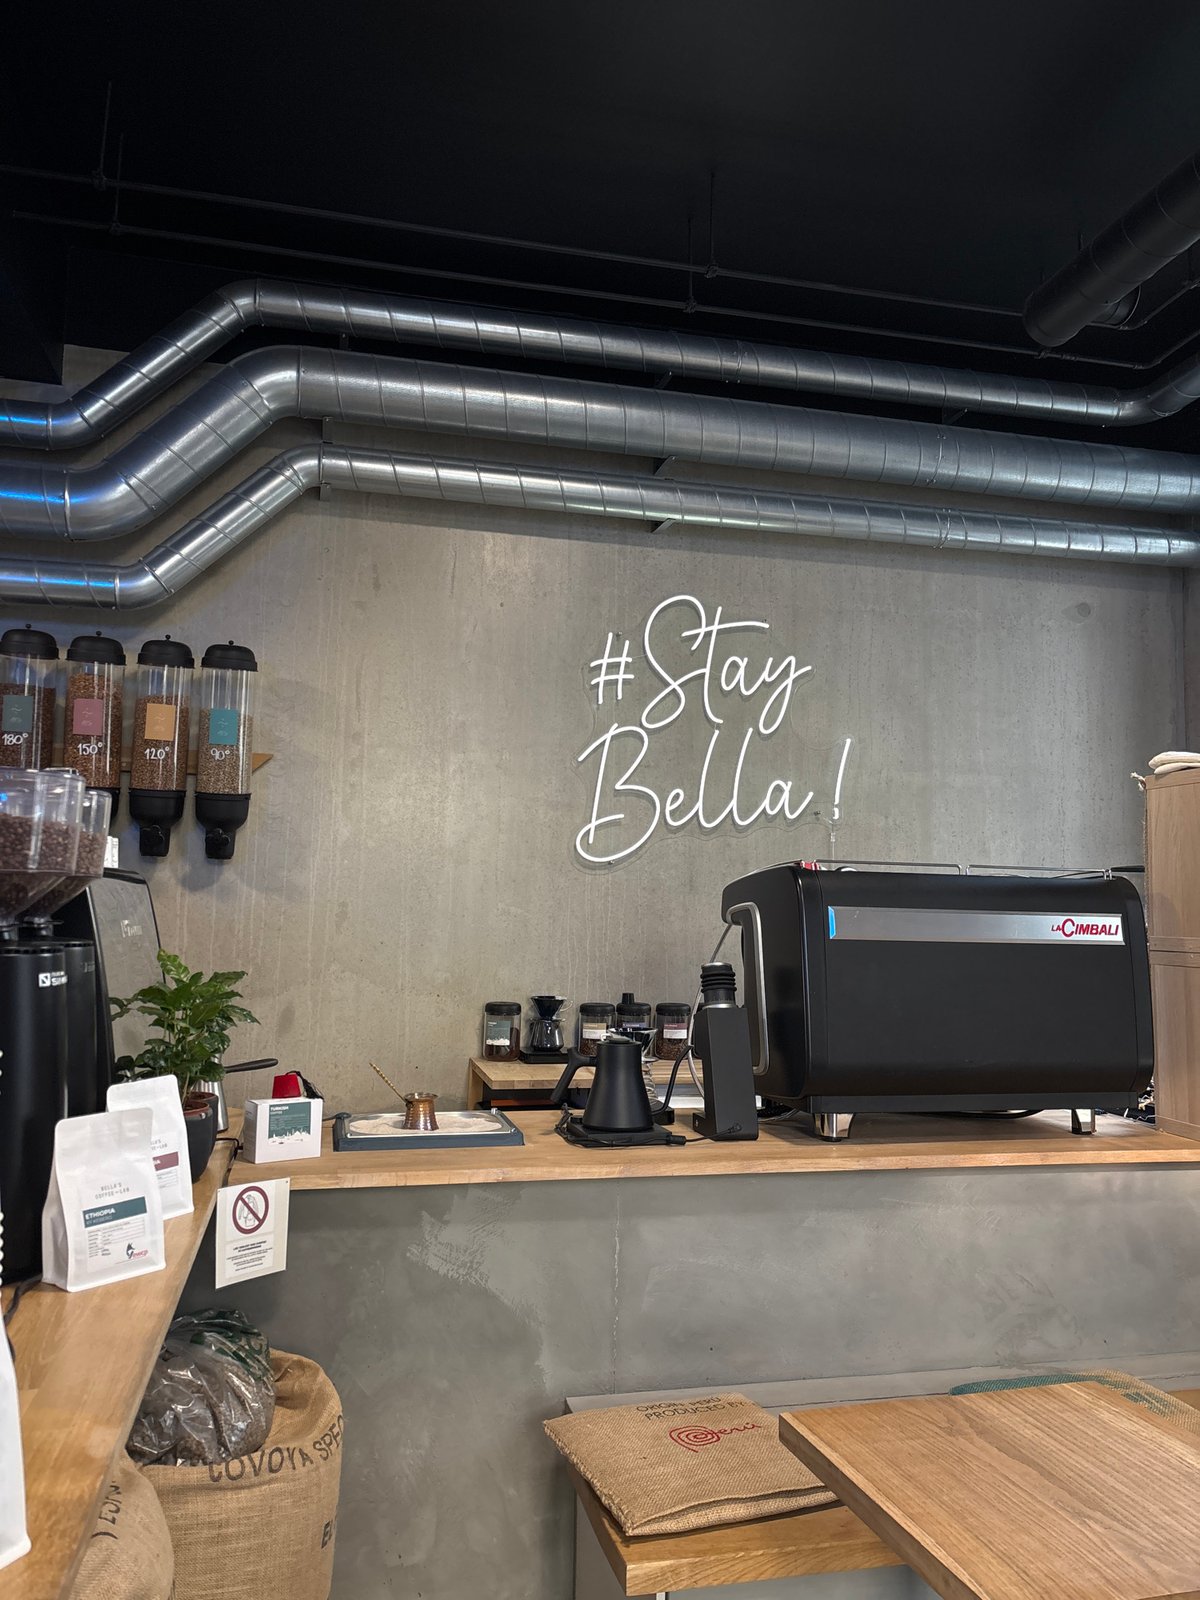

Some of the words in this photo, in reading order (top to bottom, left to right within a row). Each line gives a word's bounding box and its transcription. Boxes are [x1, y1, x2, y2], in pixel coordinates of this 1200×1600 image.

[590, 595, 811, 735] #Stay
[1, 732, 29, 747] 180°
[77, 742, 103, 756] 150°
[144, 746, 170, 760] 120°
[85, 1207, 116, 1220] ETHIOPIA
[644, 1403, 726, 1421] PRODUCED
